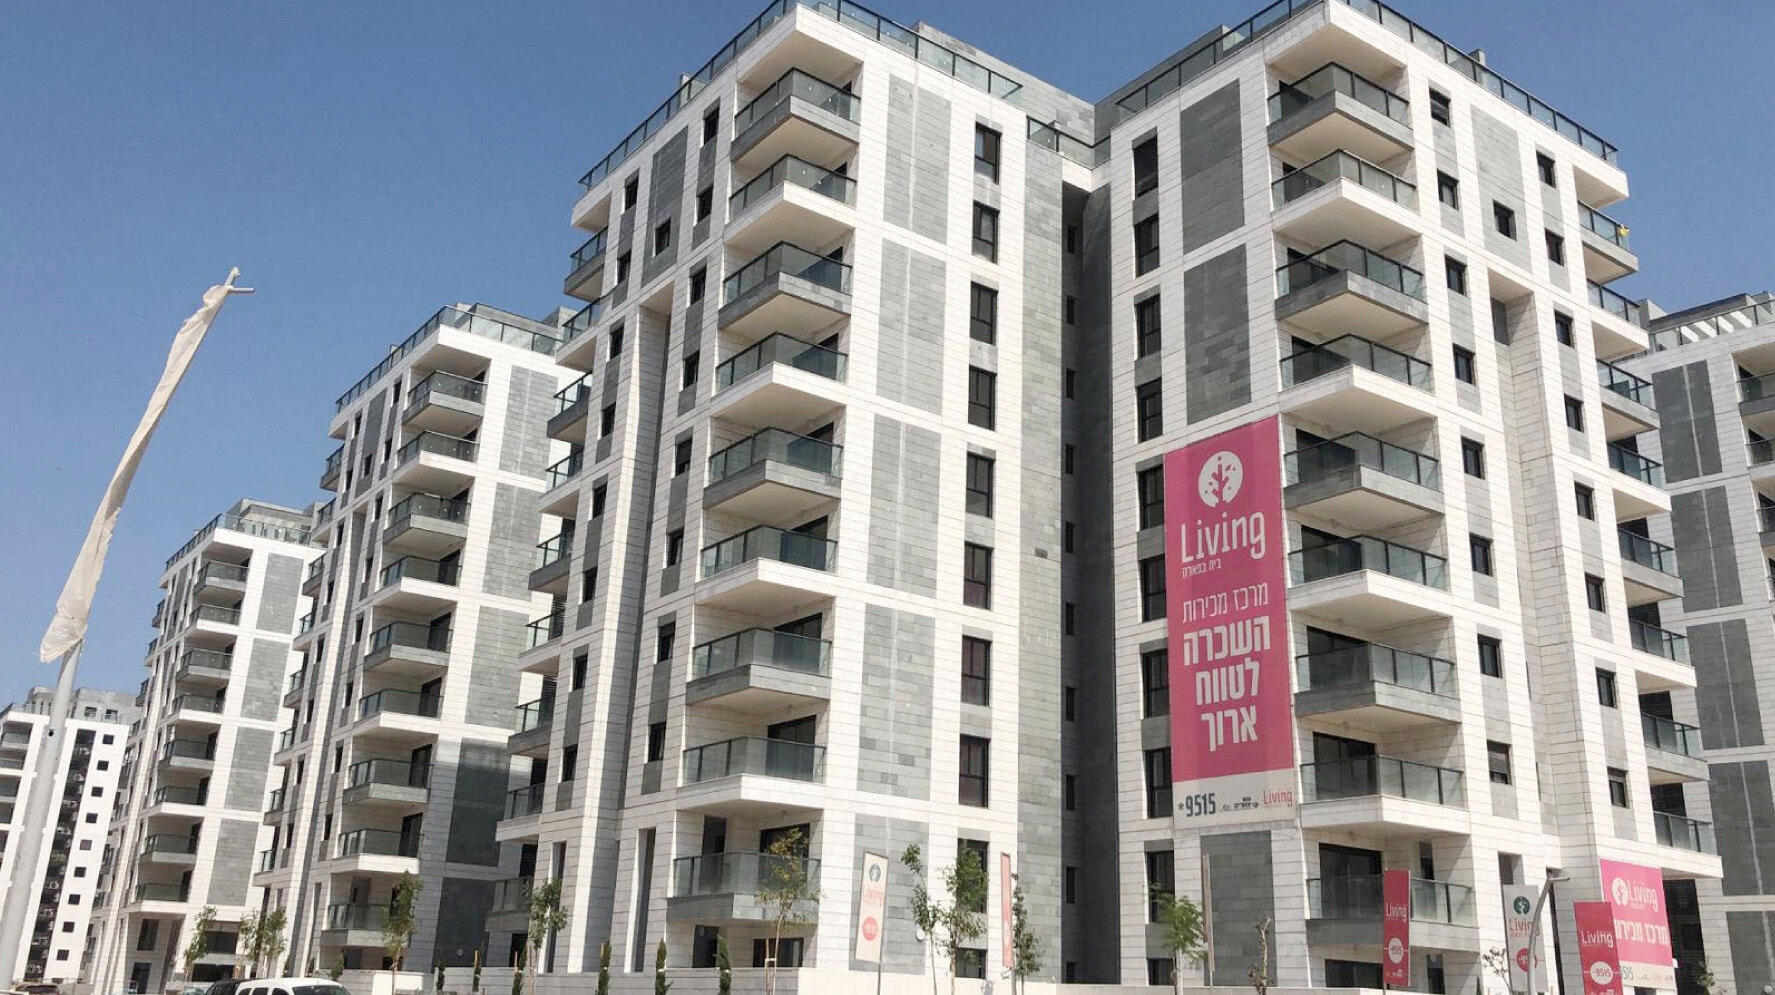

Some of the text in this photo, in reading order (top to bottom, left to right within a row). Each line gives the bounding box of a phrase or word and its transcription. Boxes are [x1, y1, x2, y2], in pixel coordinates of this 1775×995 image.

[1181, 511, 1266, 563] Living
[1182, 582, 1269, 624] מרכז מכירות
[1183, 615, 1271, 666] השכרה
[1195, 656, 1260, 706] לטווח
[1201, 704, 1259, 753] ארוך
[1262, 790, 1293, 807] Living
[1386, 901, 1407, 923] Living
[1627, 879, 1659, 912] Living
[1581, 930, 1613, 948] Living
